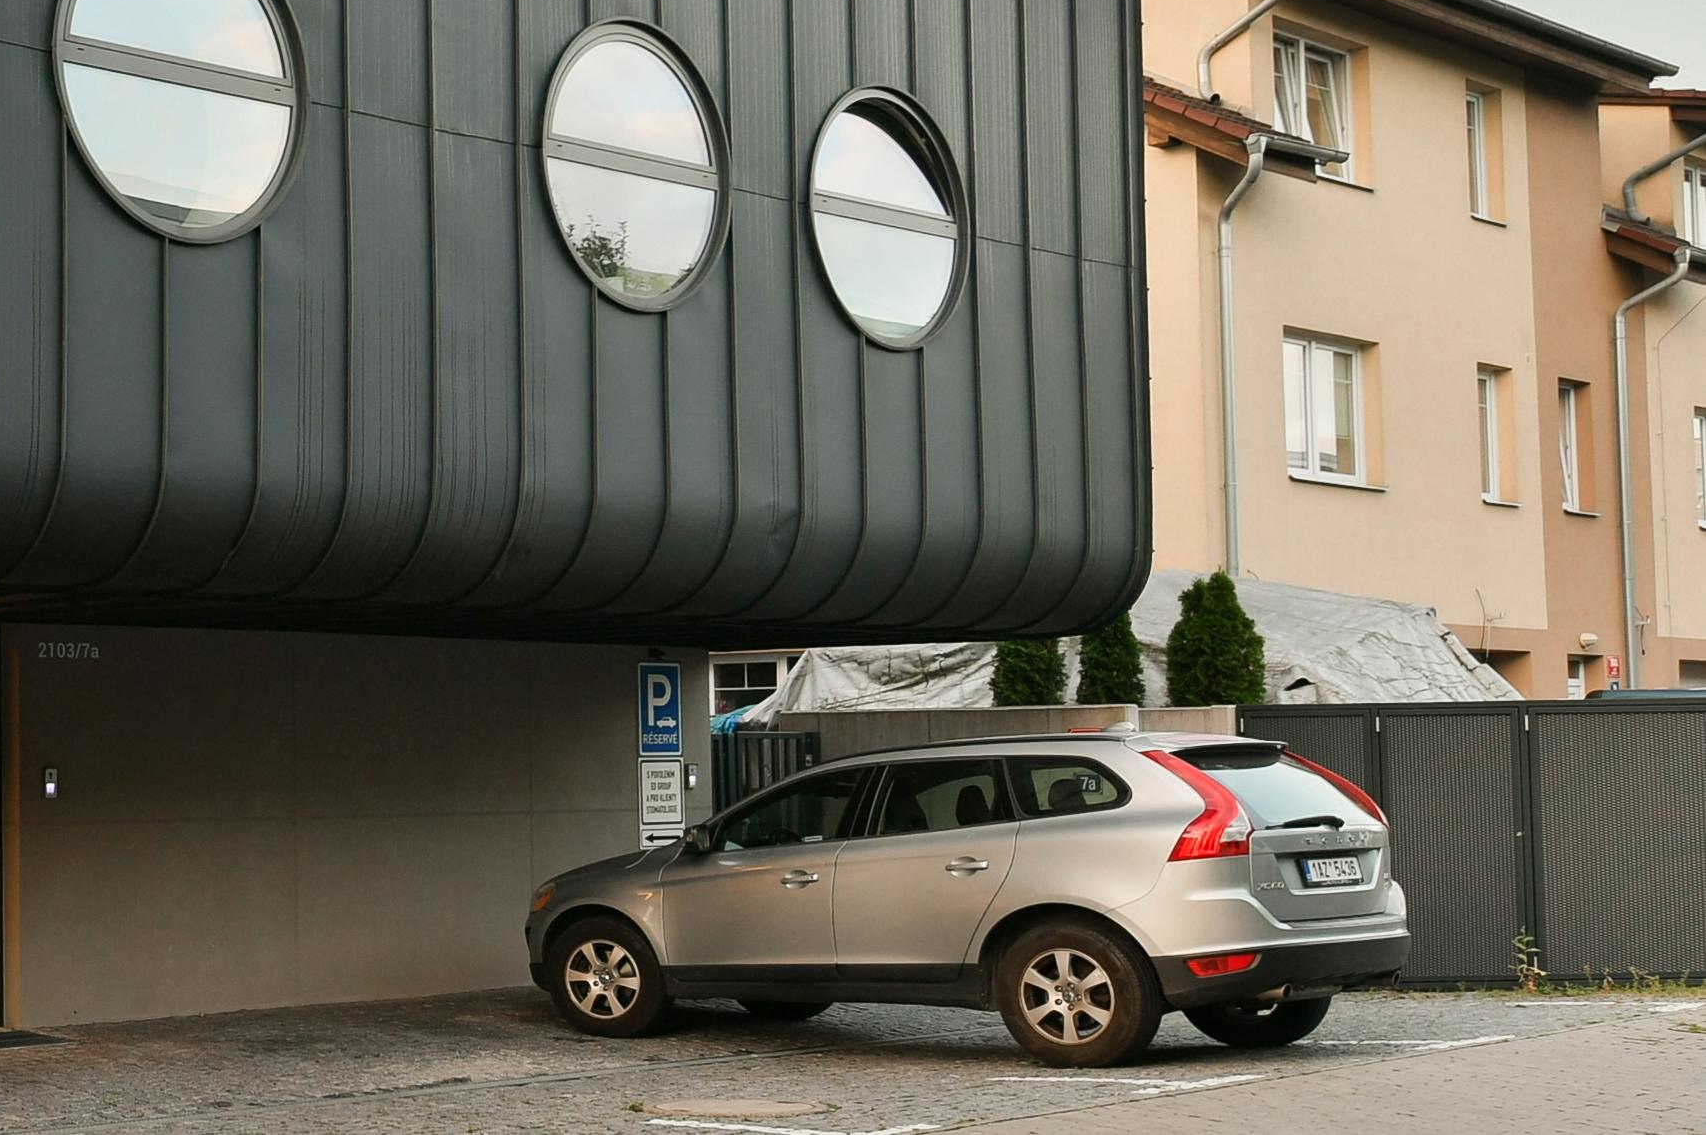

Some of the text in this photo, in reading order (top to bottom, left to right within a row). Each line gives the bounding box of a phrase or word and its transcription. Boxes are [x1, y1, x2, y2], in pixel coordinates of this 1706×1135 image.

[38, 642, 100, 658] 2103/7a
[647, 674, 672, 726] P
[1079, 776, 1096, 790] 7a
